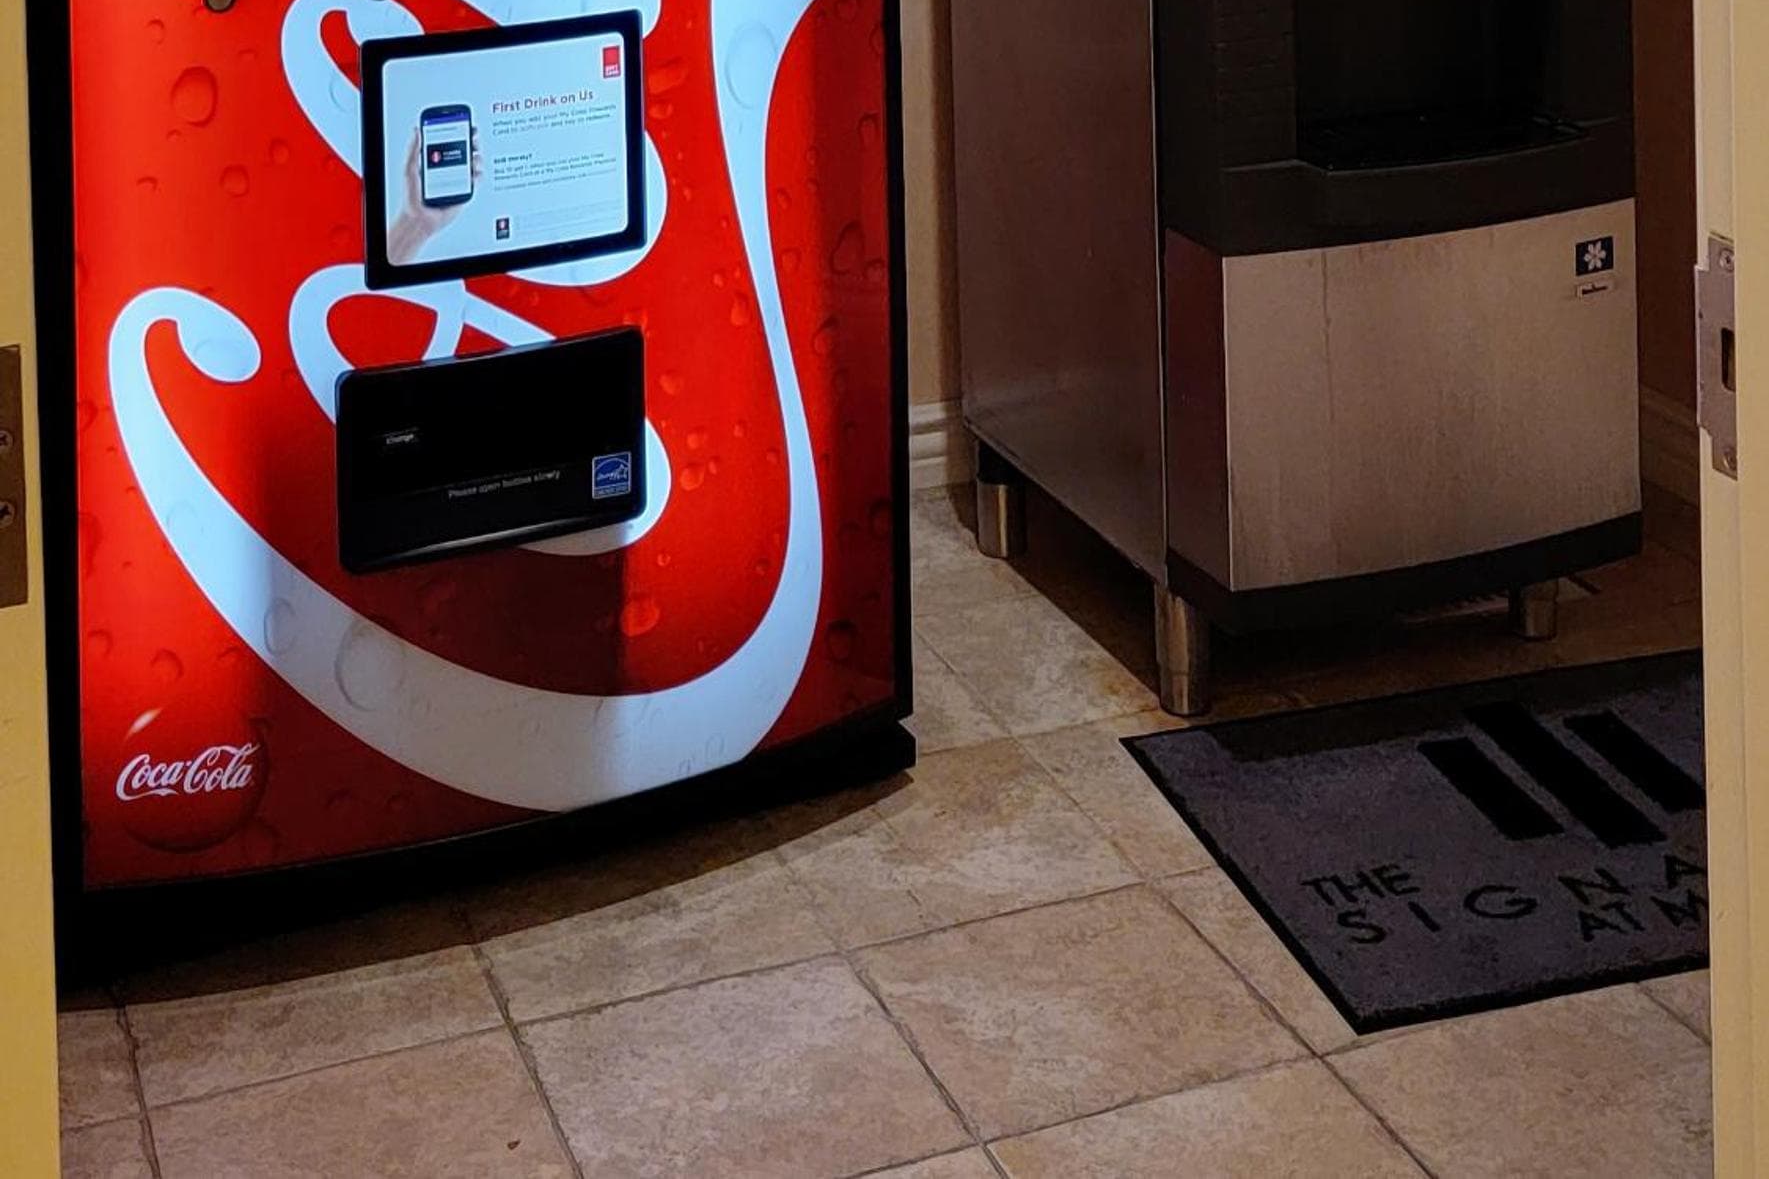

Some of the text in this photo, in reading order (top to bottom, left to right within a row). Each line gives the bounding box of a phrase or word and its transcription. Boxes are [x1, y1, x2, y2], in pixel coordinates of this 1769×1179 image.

[492, 90, 594, 114] First Drink on Us
[116, 742, 260, 801] Coca-Cola
[1300, 864, 1420, 905] THE
[1578, 902, 1646, 942] AT
